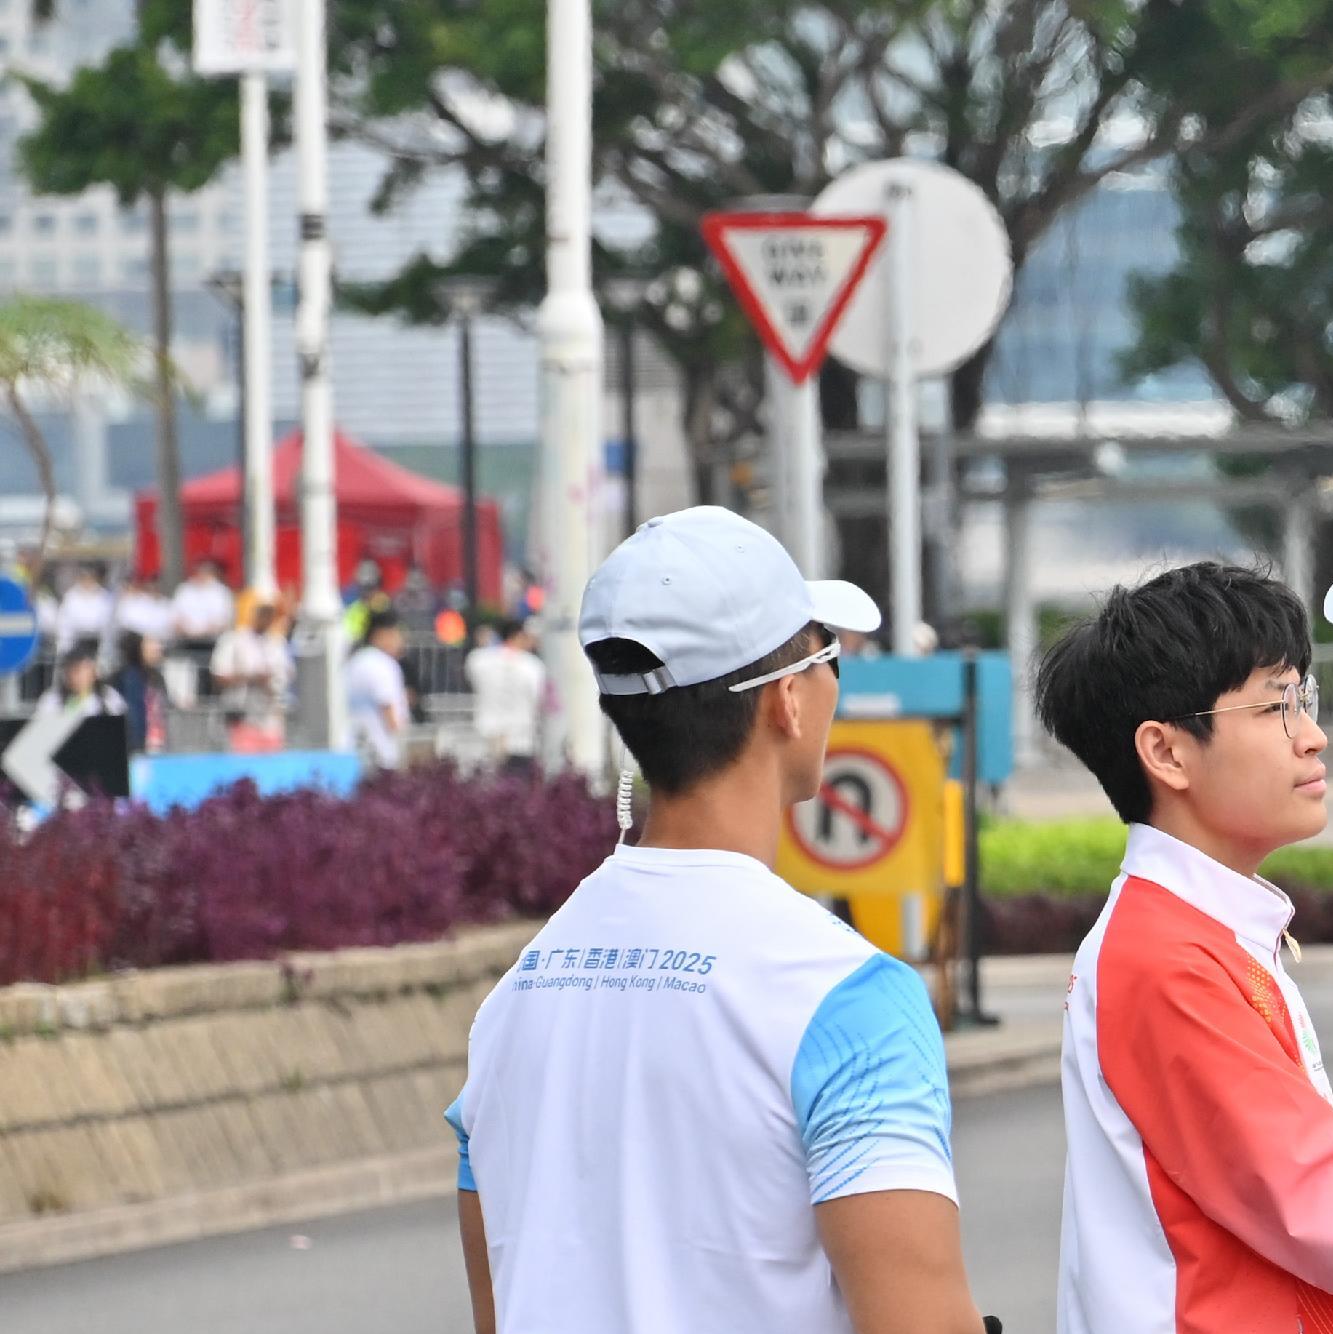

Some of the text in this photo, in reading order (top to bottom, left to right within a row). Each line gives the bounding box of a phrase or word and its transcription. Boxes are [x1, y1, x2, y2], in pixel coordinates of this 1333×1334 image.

[659, 950, 716, 975] 2025
[600, 975, 628, 991] Hong
[629, 975, 656, 991] Kong
[663, 976, 706, 994] Macao
